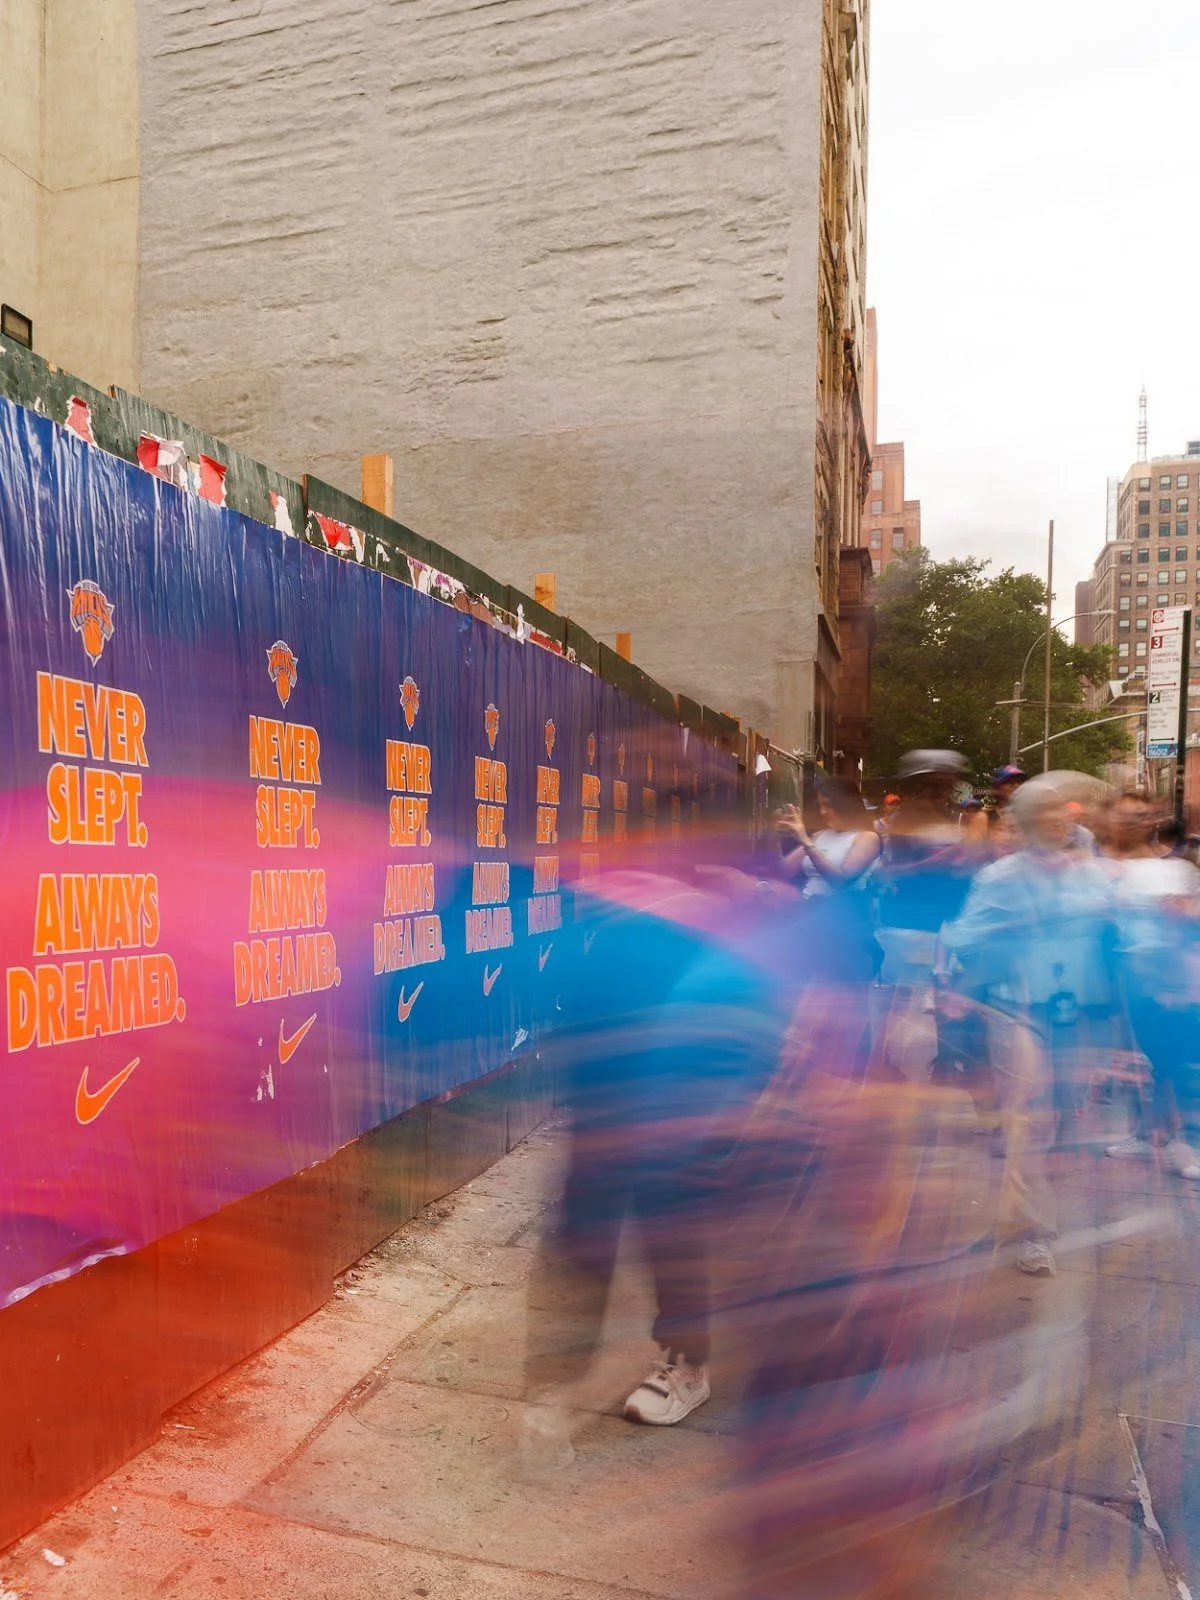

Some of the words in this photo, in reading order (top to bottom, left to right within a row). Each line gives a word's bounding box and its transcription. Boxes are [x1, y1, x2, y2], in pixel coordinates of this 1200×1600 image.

[1153, 637, 1161, 649] 3
[36, 671, 149, 768] NEVER
[1152, 692, 1159, 703] 2
[249, 714, 322, 785] NEVER
[386, 738, 432, 794] NEVER
[46, 762, 148, 849] SLEPT.
[254, 784, 320, 849] SLEPT.
[389, 795, 432, 848] SLEPT.
[32, 872, 160, 957] ALWAYS
[248, 869, 327, 934] ALWAYS
[384, 863, 435, 917] ALWAYS
[233, 932, 342, 1007] DREAMED.
[374, 914, 446, 976] DREAMED.
[6, 952, 185, 1053] DREAMED.
